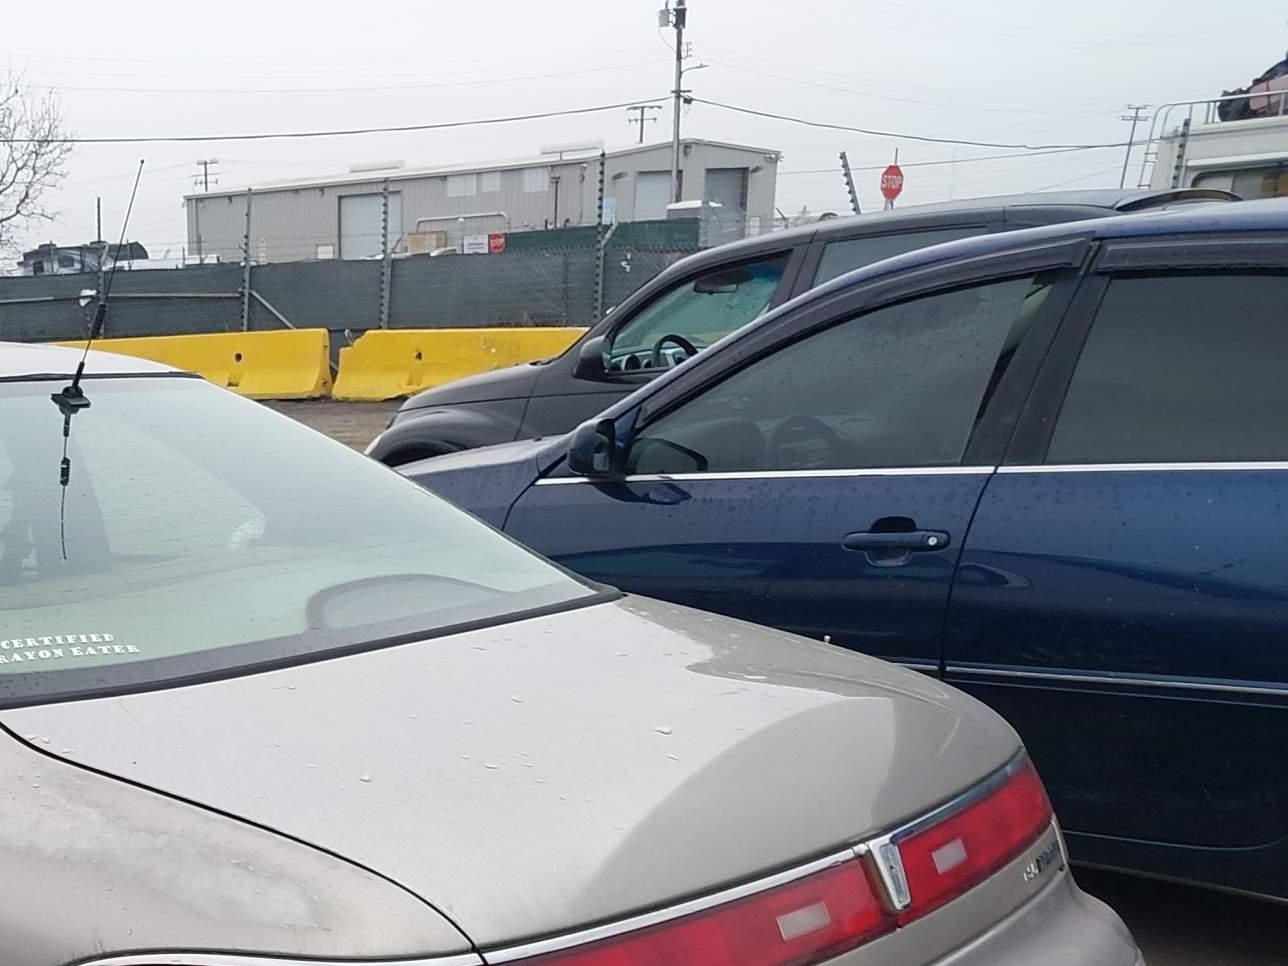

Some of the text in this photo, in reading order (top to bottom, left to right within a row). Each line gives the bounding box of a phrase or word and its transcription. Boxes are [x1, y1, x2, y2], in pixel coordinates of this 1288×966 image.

[882, 174, 902, 189] STOP
[0, 633, 114, 650] CERTIFIED
[70, 644, 141, 657] EATER
